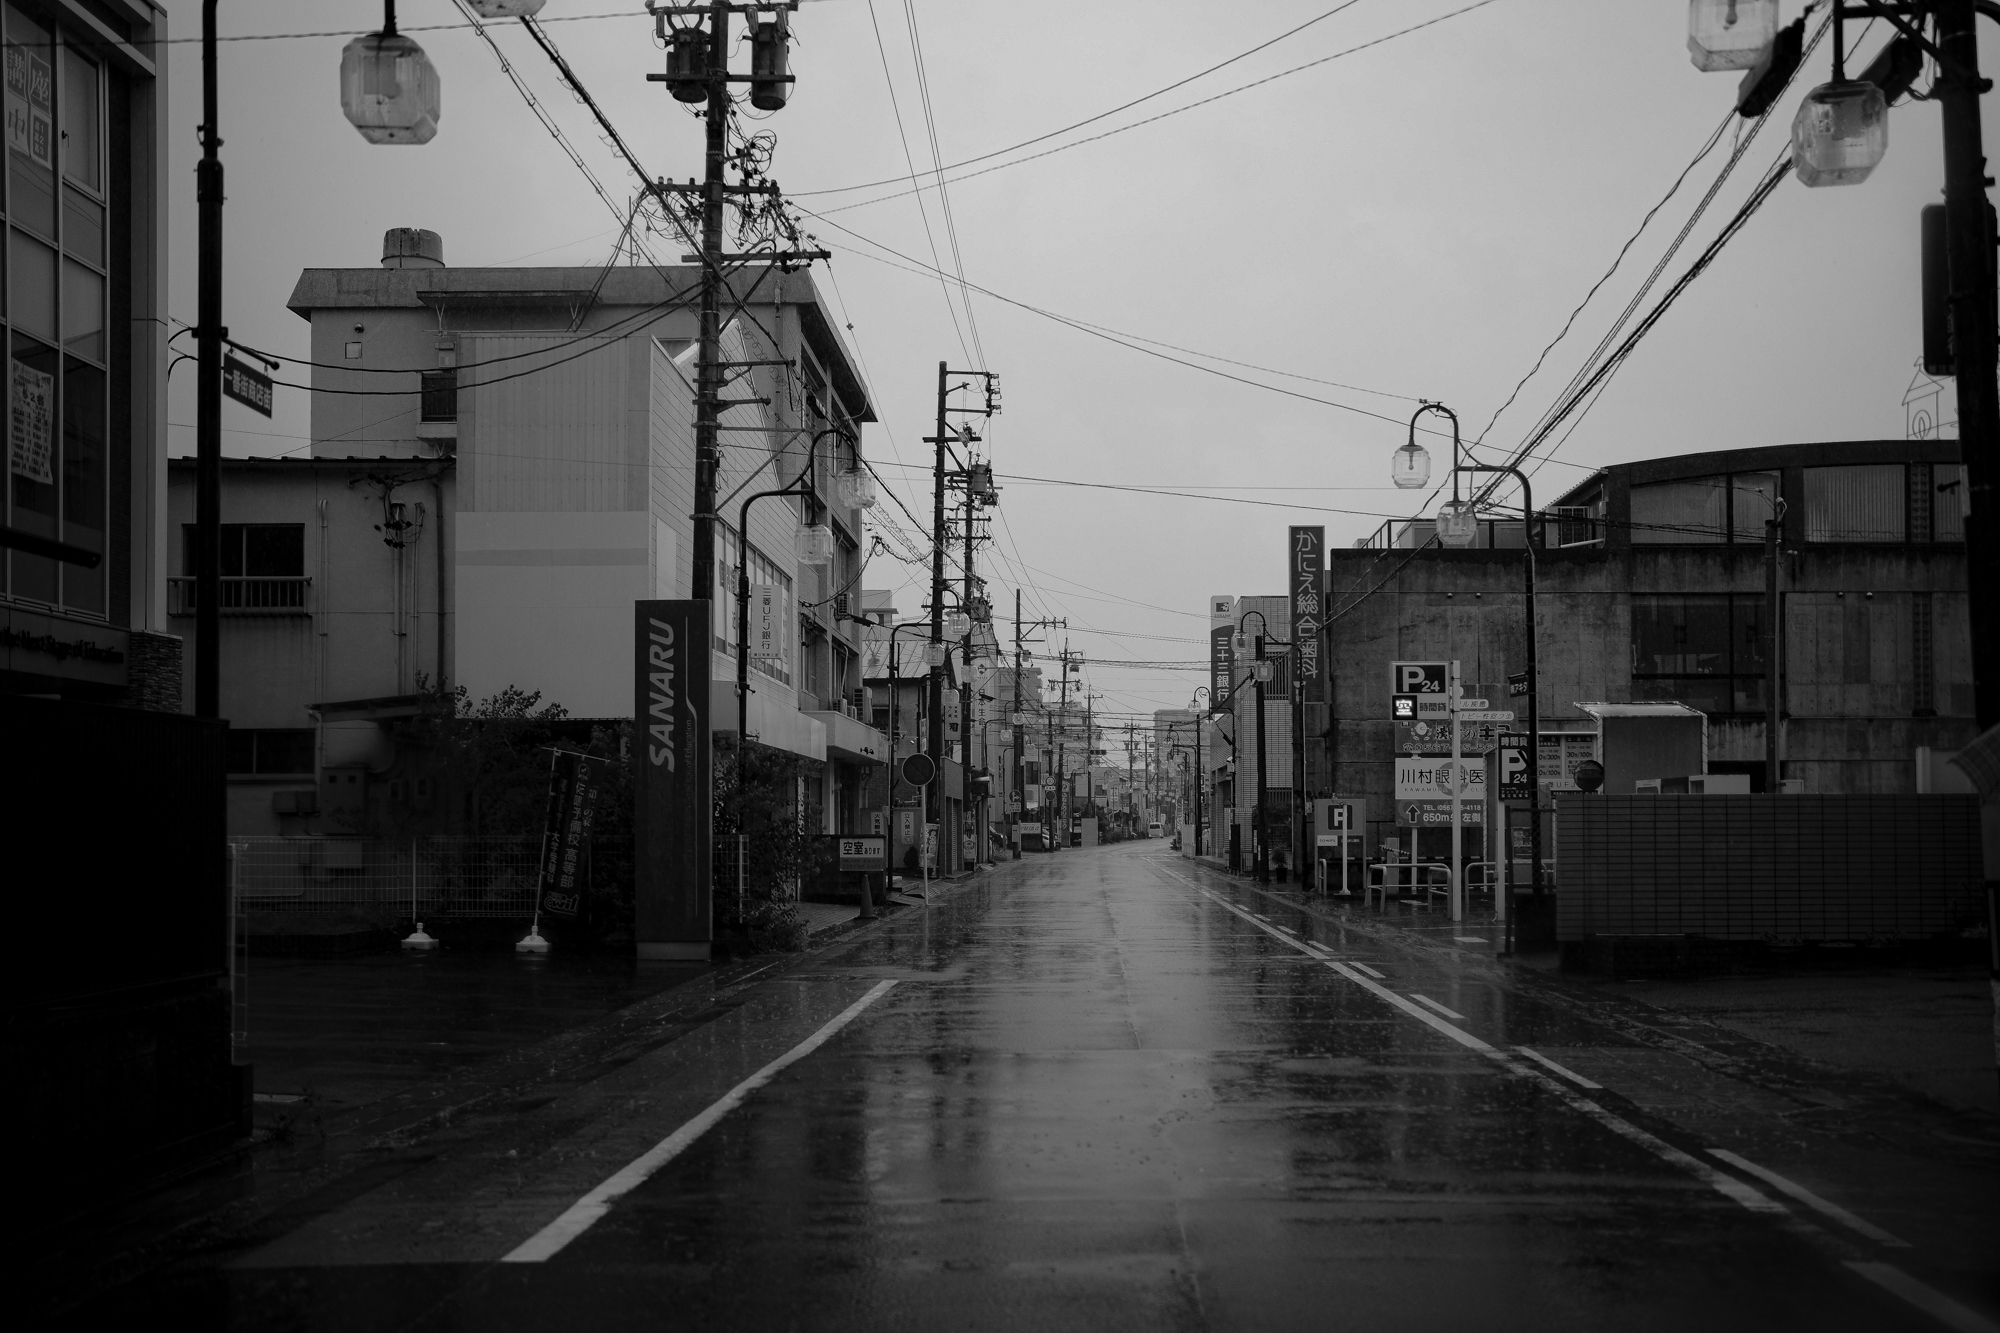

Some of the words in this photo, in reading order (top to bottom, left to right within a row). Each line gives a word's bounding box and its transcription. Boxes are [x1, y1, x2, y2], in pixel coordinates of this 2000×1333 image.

[9, 108, 25, 140] 中
[762, 587, 772, 650] 三菱UFJ銀行
[1296, 530, 1320, 679] かにえ総合歯科
[1216, 637, 1229, 702] 三十三銀行
[649, 616, 675, 773] SANARU
[1395, 699, 1413, 716] 空
[1419, 702, 1446, 712] 時間貸
[1501, 736, 1528, 746] 時間貸
[843, 840, 880, 855] 空室あります
[560, 848, 578, 888] 高等部
